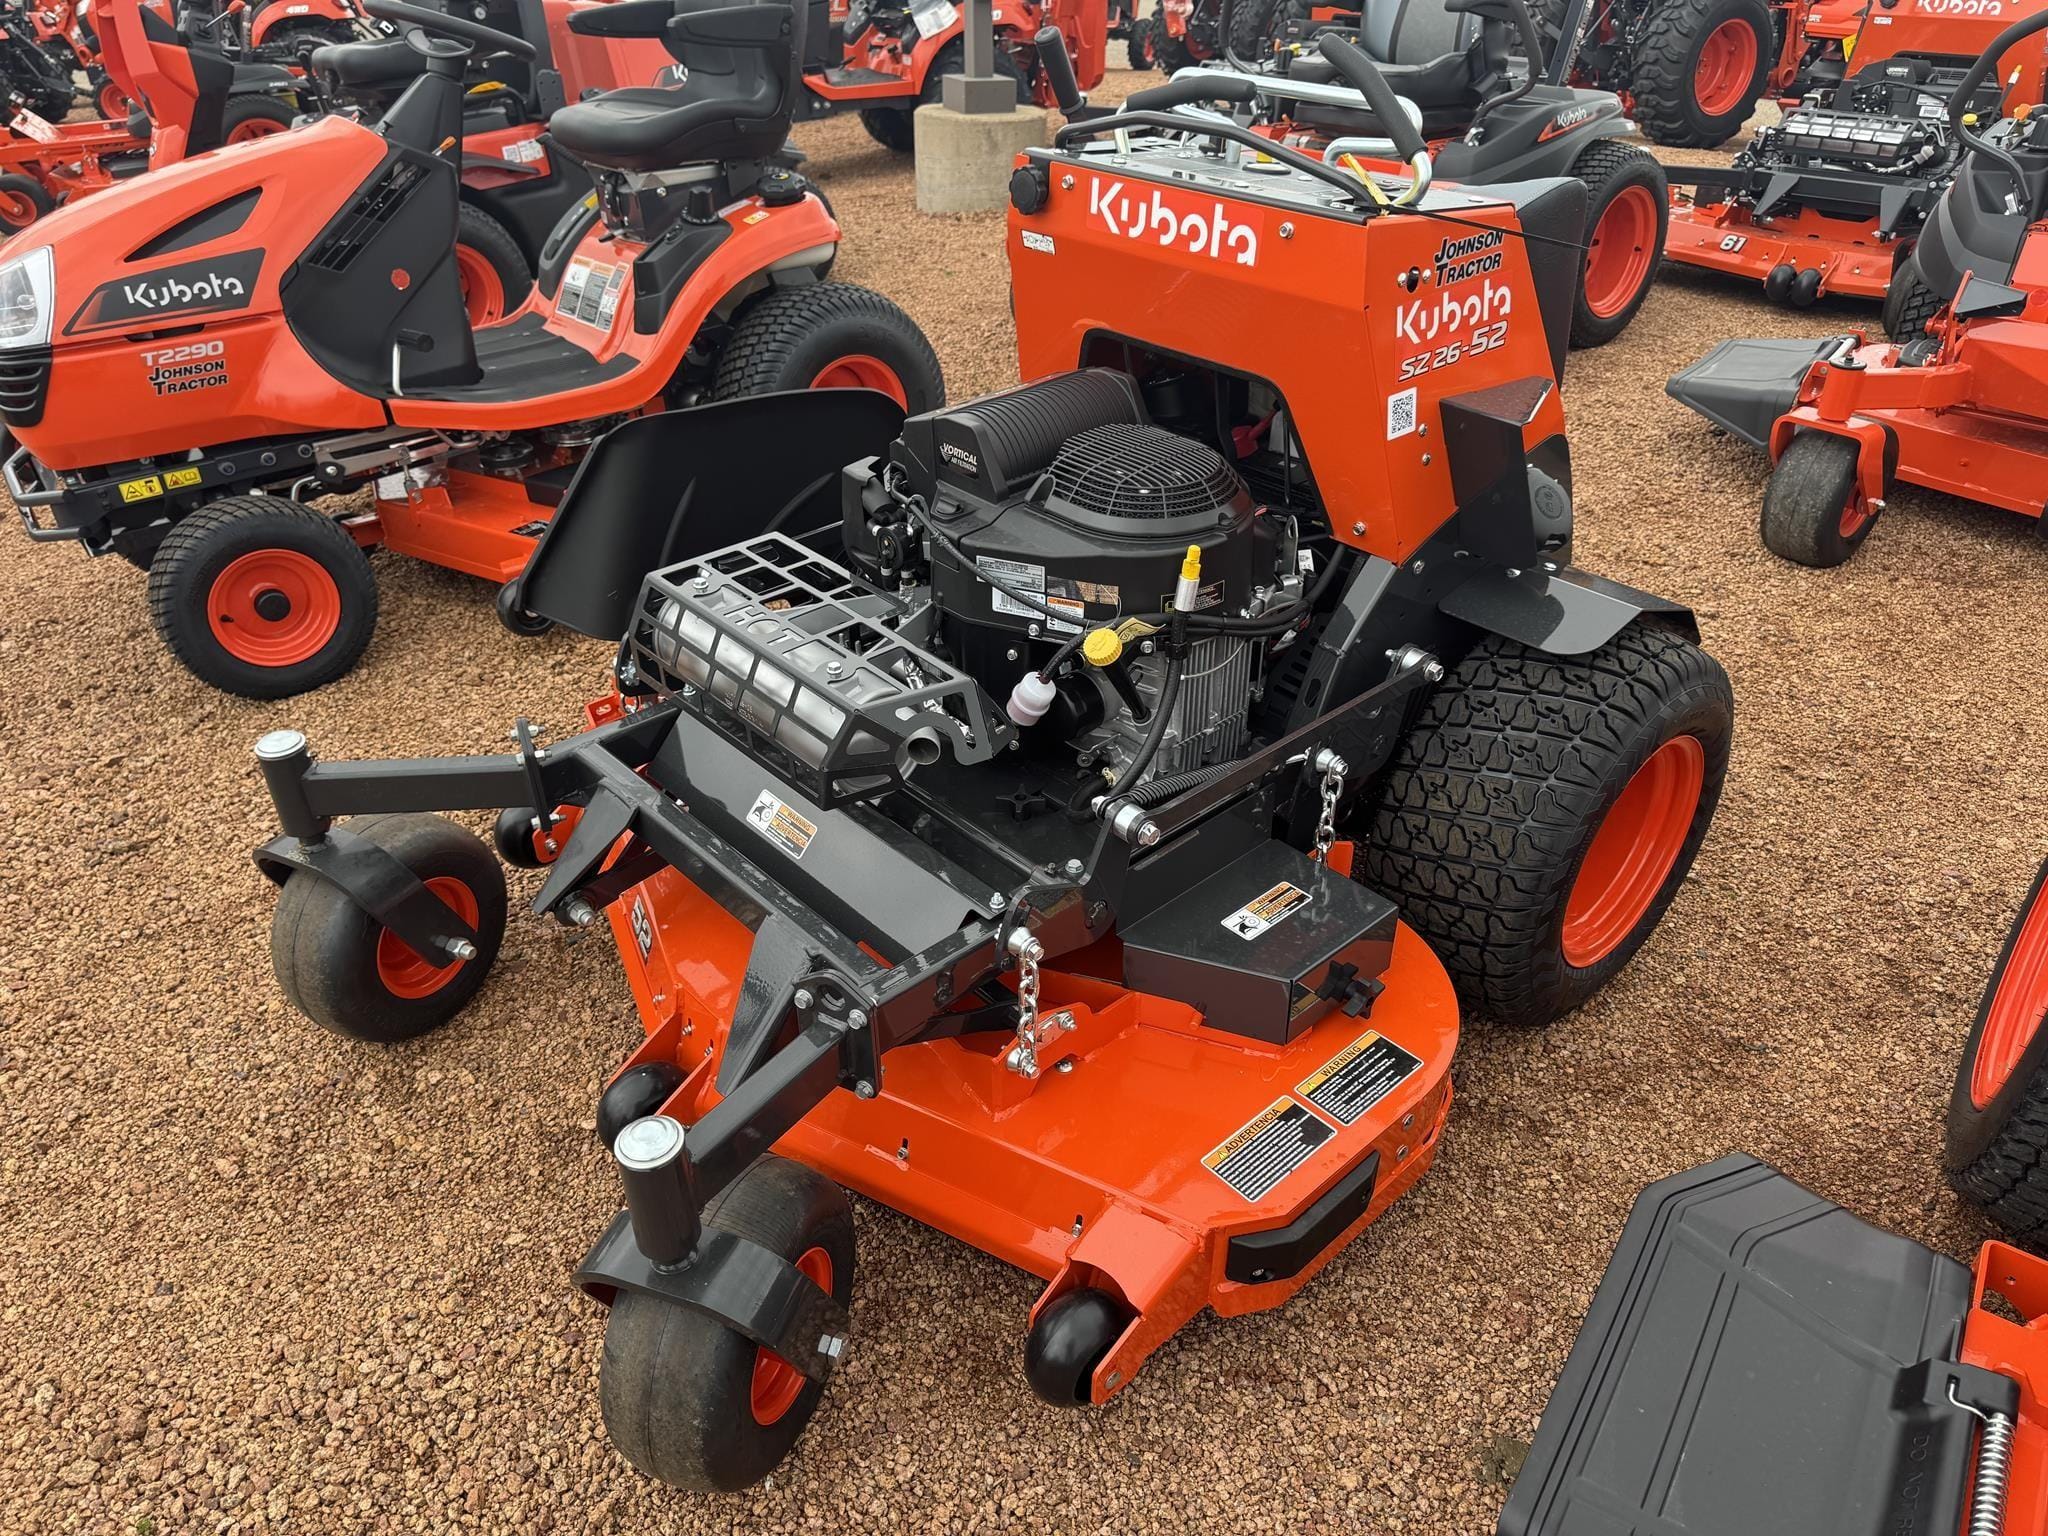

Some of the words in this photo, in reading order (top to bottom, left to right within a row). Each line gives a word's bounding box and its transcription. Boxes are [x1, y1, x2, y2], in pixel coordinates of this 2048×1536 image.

[1557, 106, 1587, 127] Kubota
[1090, 177, 1257, 267] Kubota
[1434, 230, 1505, 264] JOHNSON
[1719, 234, 1748, 253] 61
[1435, 252, 1502, 288] TRACTOR
[123, 273, 244, 308] Kubota
[1396, 278, 1512, 345] Kubota
[140, 340, 225, 366] T2290
[148, 360, 225, 382] JOHNSON
[153, 374, 228, 395] TRACTOR
[943, 442, 978, 466] VORTICAL
[722, 604, 807, 646] HOT
[787, 811, 812, 832] WARNING
[1257, 886, 1284, 905] WARNING
[1321, 1045, 1362, 1077] WARNING
[1225, 1108, 1281, 1154] ADVERTENCIA
